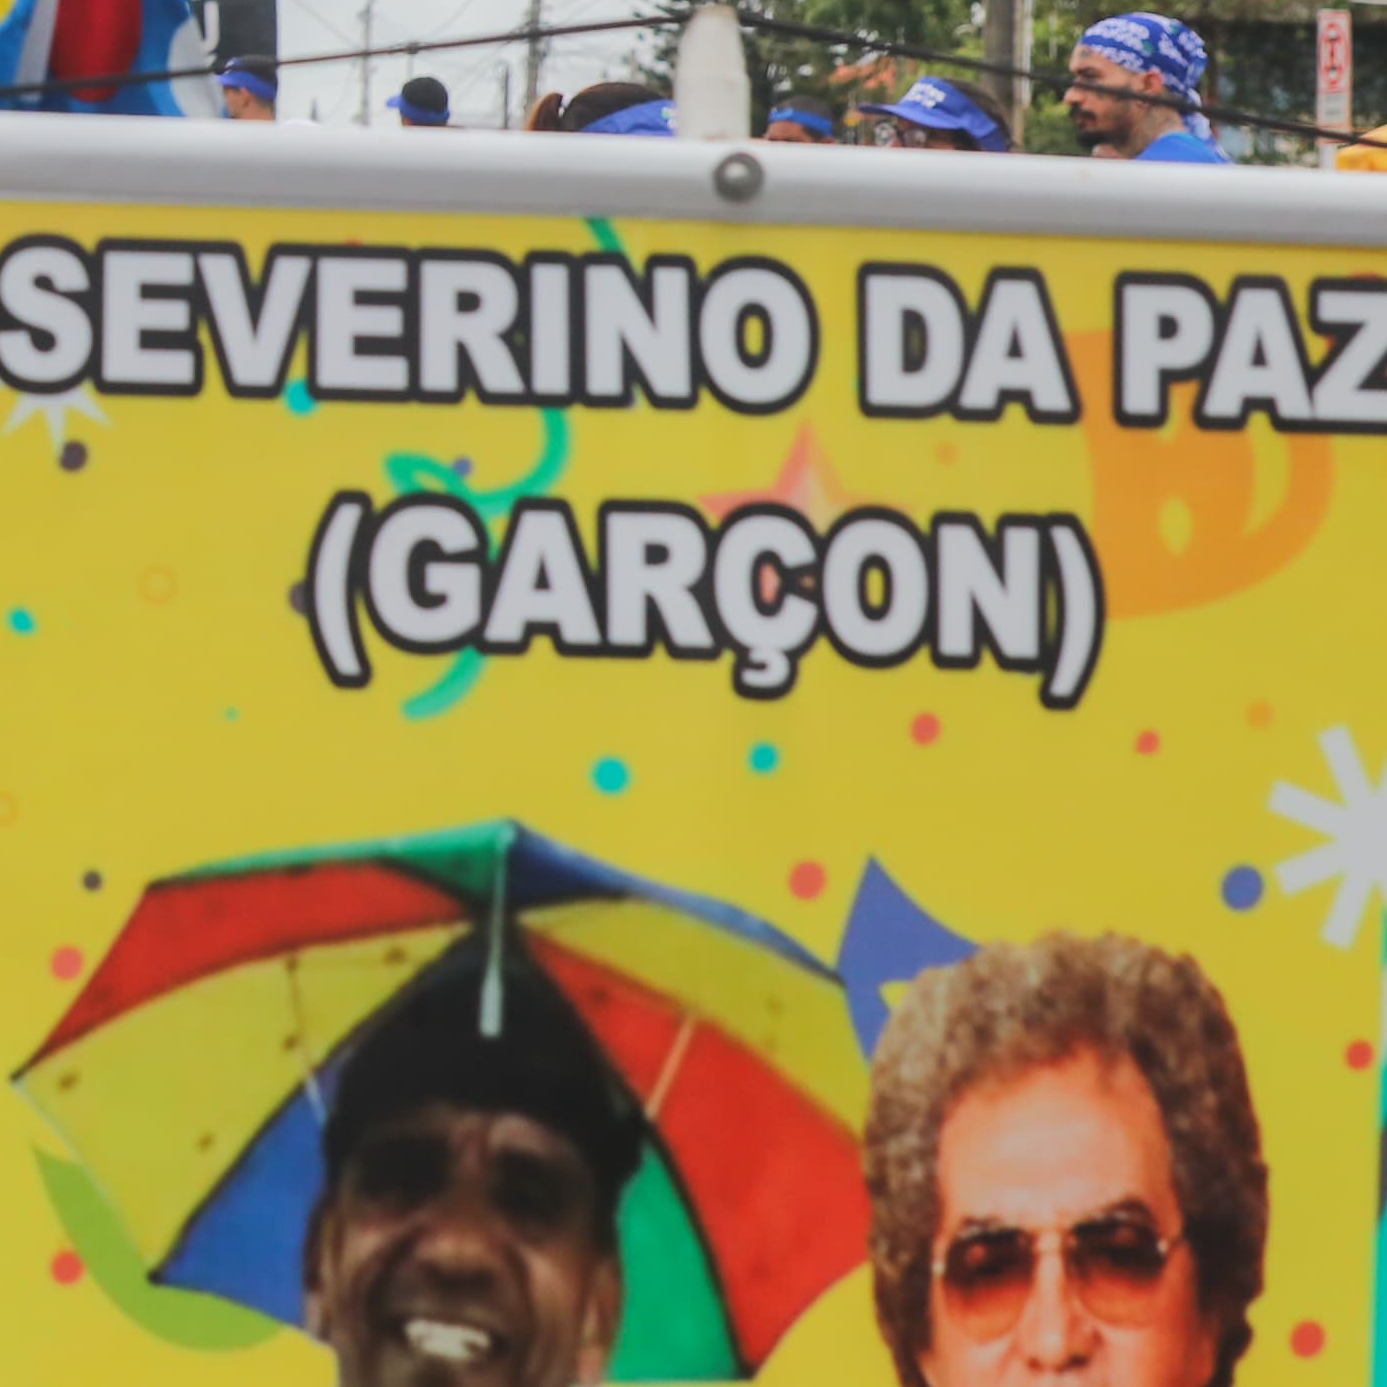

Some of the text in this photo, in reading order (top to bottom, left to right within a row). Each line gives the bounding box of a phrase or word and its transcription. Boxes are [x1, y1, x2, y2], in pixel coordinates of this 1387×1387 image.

[856, 260, 1082, 424] DA
[1113, 269, 1387, 436] PAZ
[306, 490, 1107, 711] (GARÇON)
